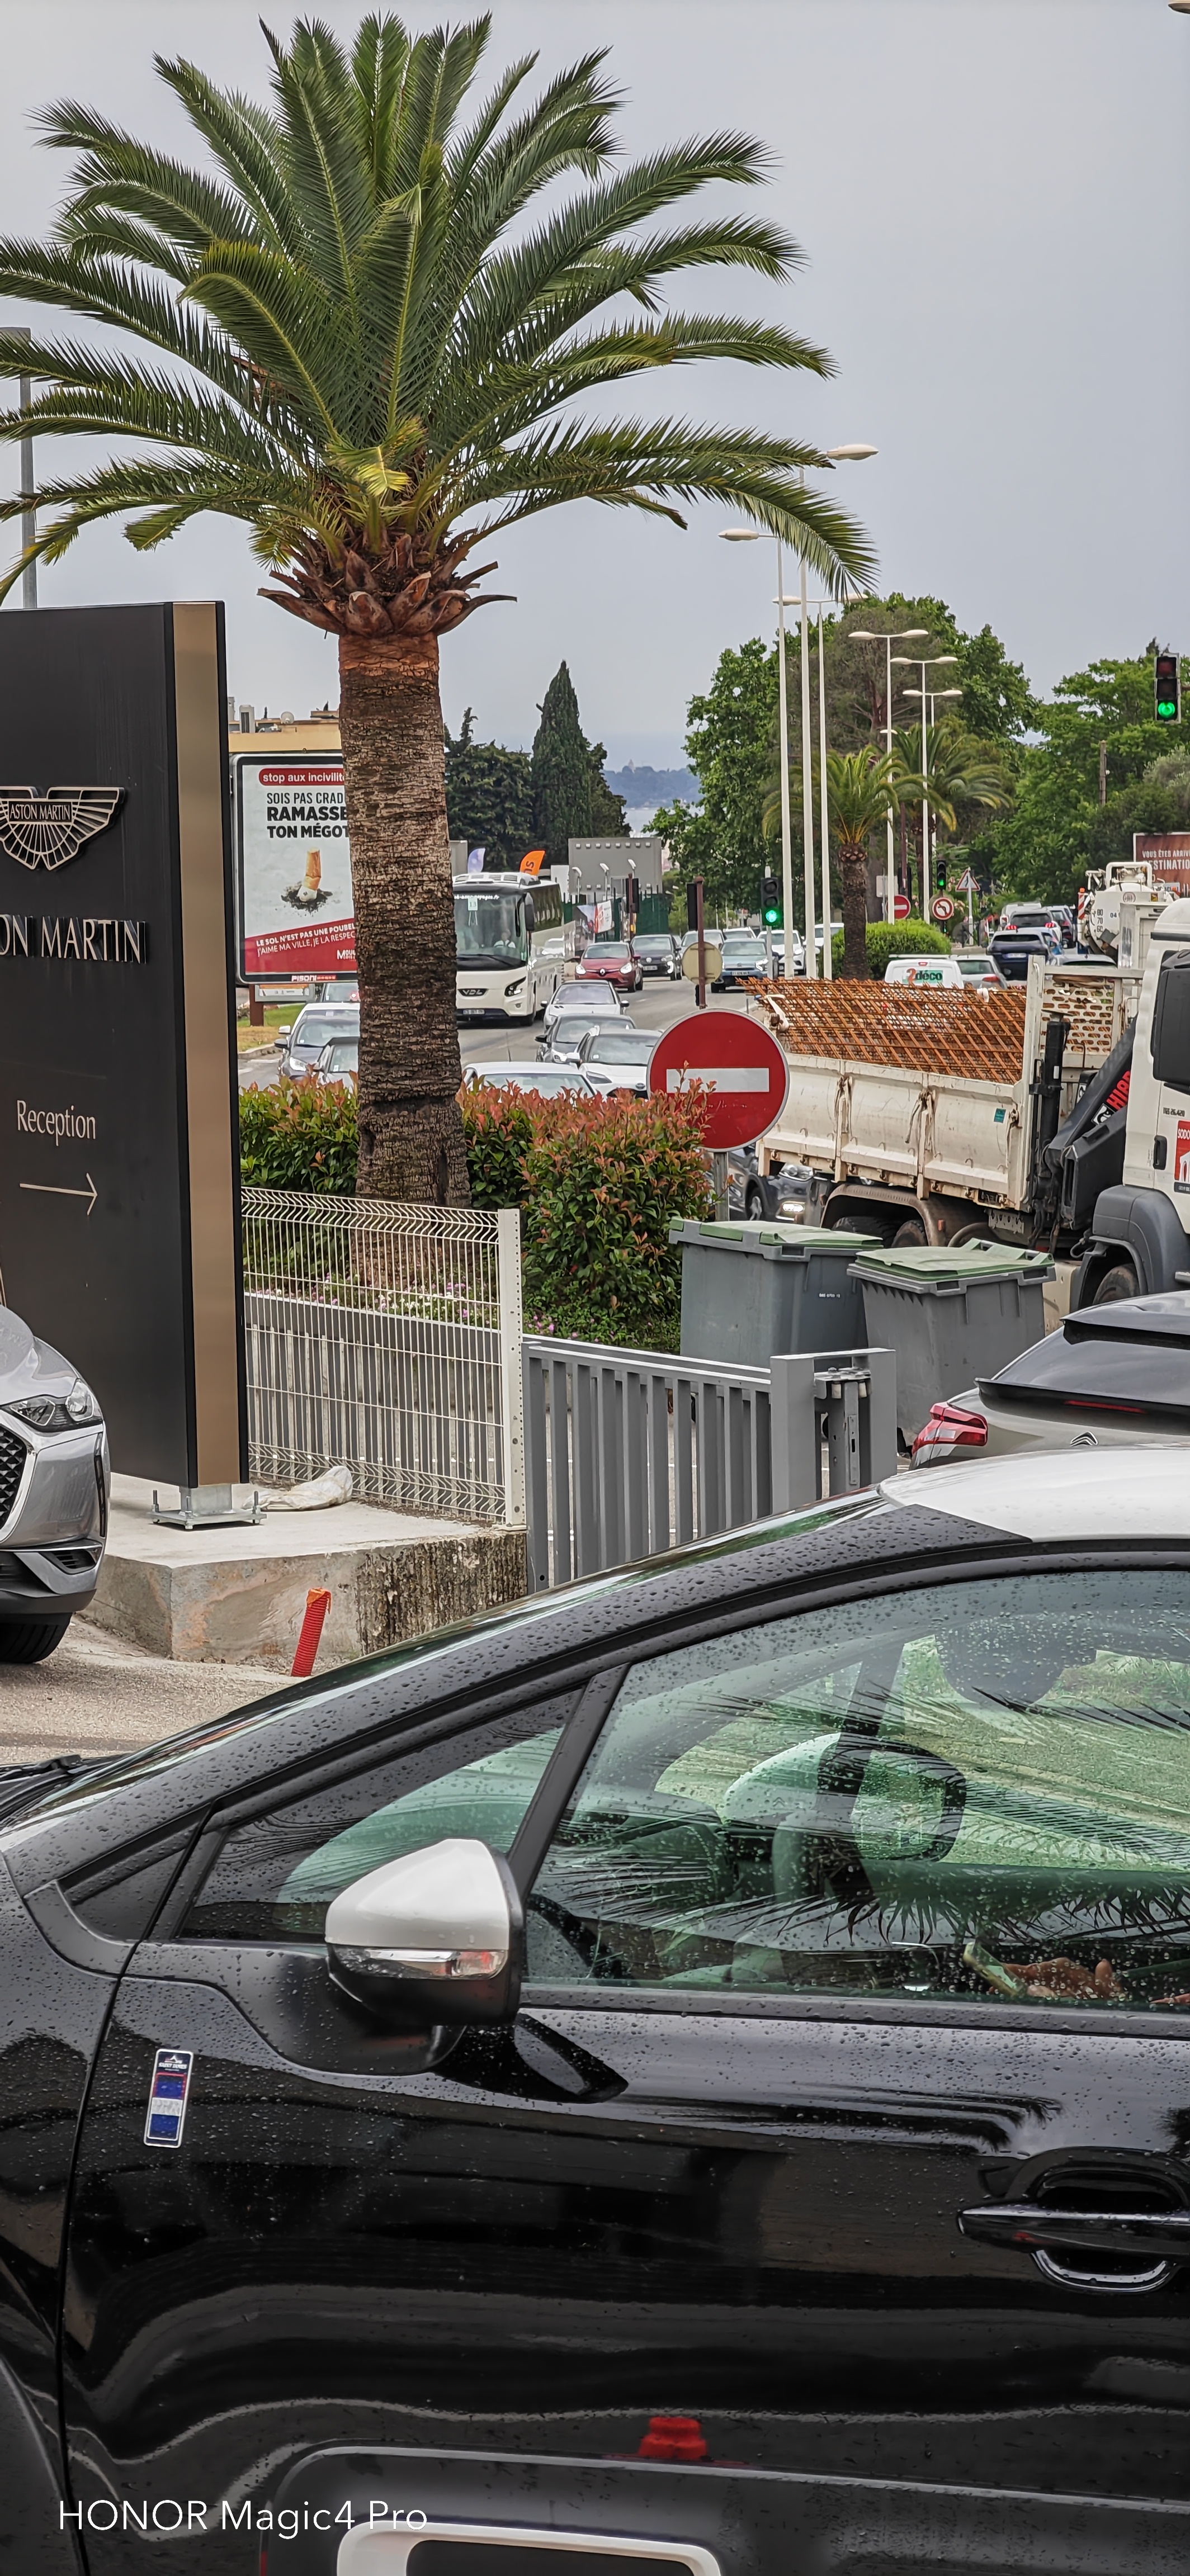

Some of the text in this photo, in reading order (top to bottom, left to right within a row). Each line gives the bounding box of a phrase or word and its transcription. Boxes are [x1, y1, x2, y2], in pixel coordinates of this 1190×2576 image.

[263, 773, 285, 784] stop
[267, 792, 290, 804] SOIS
[294, 792, 313, 804] PAS
[10, 803, 70, 821] ASTON MARTIN
[267, 806, 348, 822] RAMASSE
[267, 822, 349, 839] TON MÉGOT
[1142, 849, 1190, 858] VOUS ÊTES ARRIV
[41, 915, 141, 964] MARTIN
[257, 945, 278, 958] J'AIME
[279, 943, 291, 951] MA
[313, 937, 320, 948] JE
[320, 935, 330, 944] LA
[330, 931, 356, 943] RESPEC
[266, 937, 279, 945] SOL
[280, 933, 299, 943] N'EST
[300, 930, 313, 940] PAS
[314, 927, 328, 936] UNE
[17, 1099, 96, 1147] Reception
